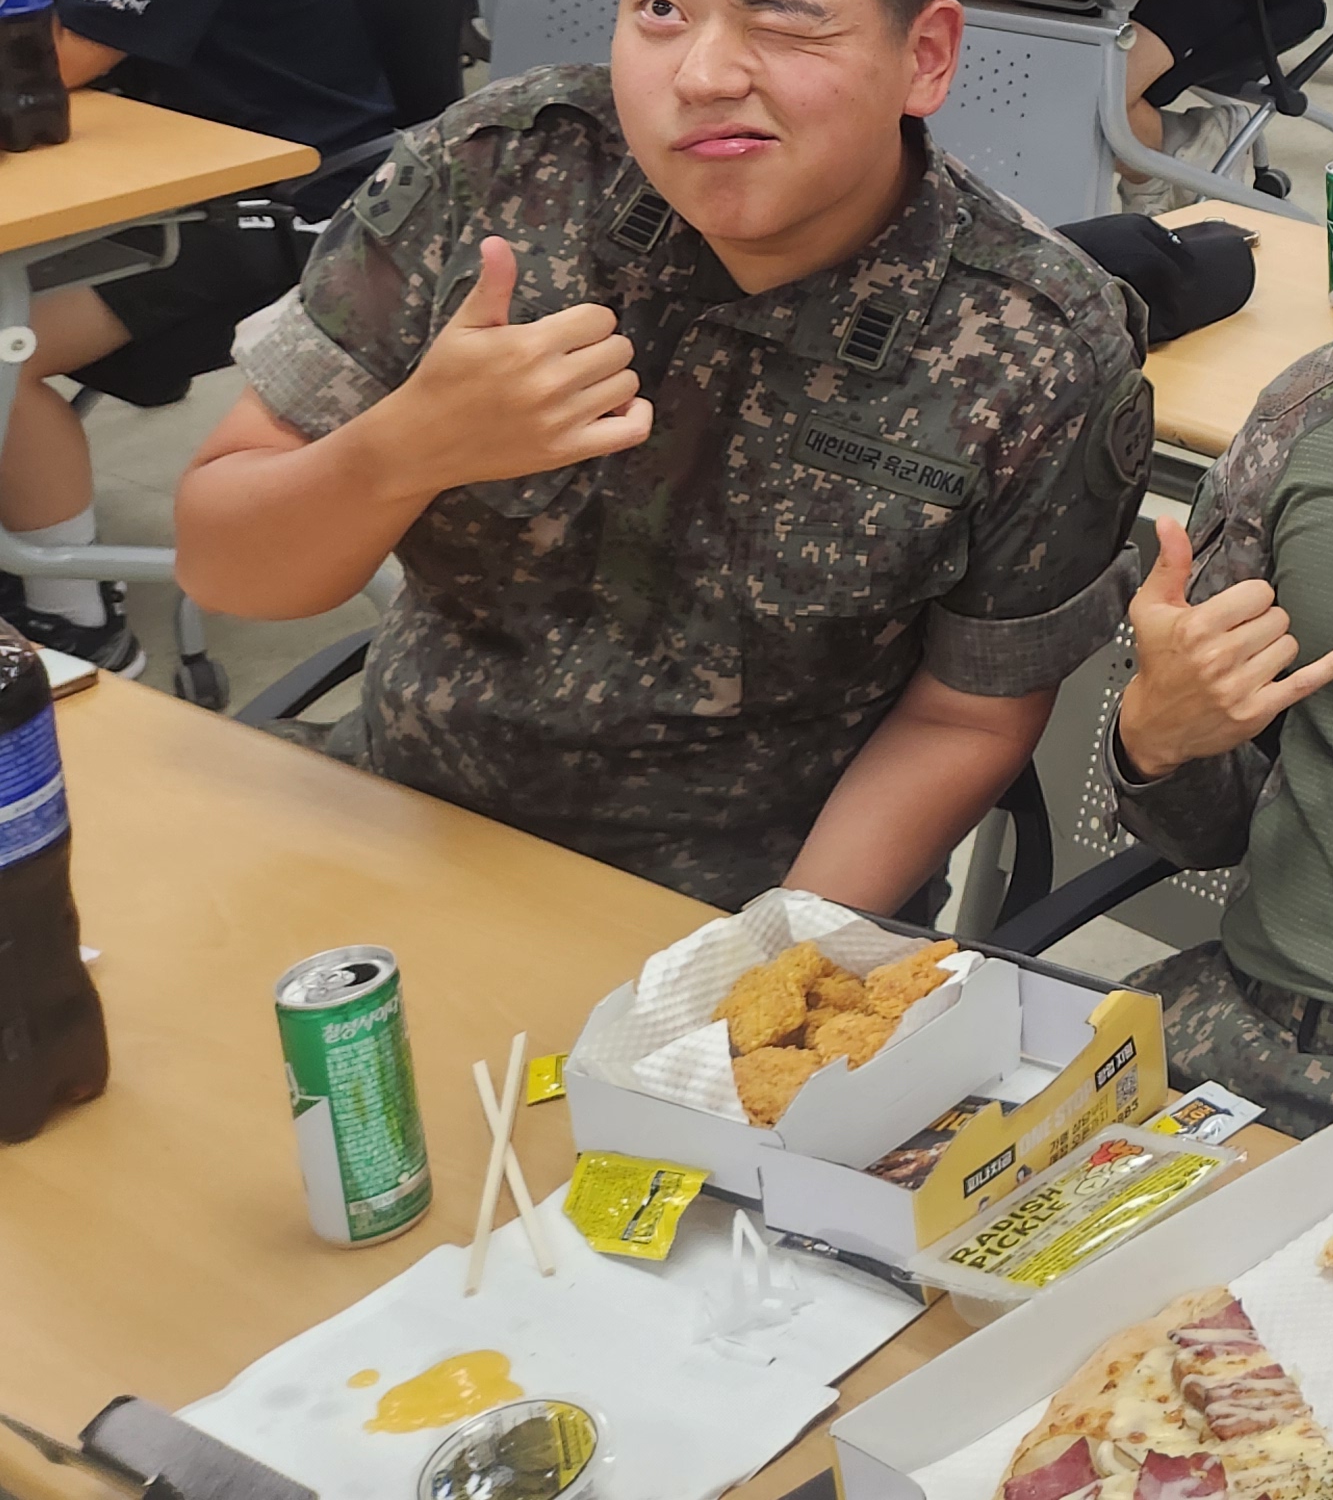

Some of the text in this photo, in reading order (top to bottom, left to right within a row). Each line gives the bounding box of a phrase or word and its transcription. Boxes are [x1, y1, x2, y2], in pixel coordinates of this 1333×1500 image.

[805, 428, 964, 496] 대한민국 육군 ROKA
[949, 1186, 1063, 1264] RADISH
[967, 1201, 1071, 1269] PICKLE
